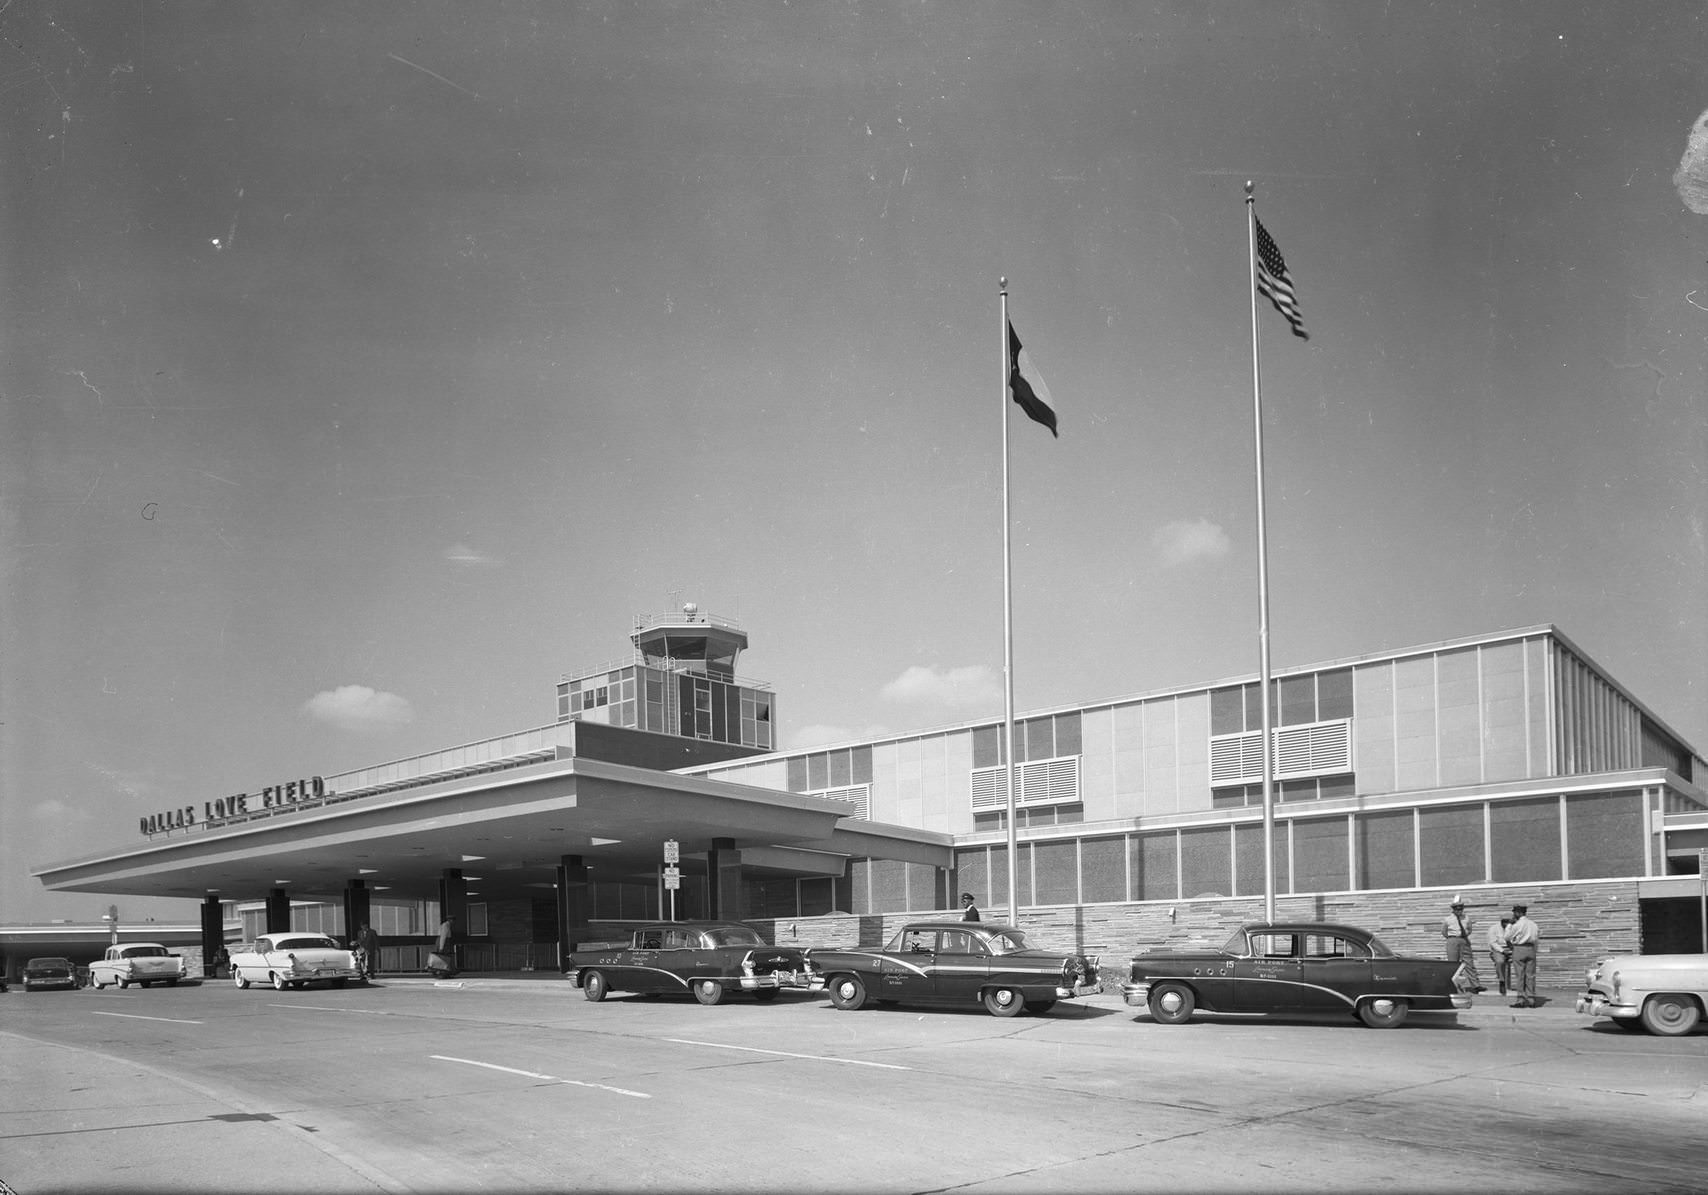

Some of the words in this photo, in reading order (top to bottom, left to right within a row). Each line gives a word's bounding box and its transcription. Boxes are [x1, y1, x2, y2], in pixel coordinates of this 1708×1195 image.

[140, 806, 194, 834] DALLAS
[205, 794, 247, 819] LOVE
[263, 776, 324, 808] FIELD
[872, 959, 881, 967] 27
